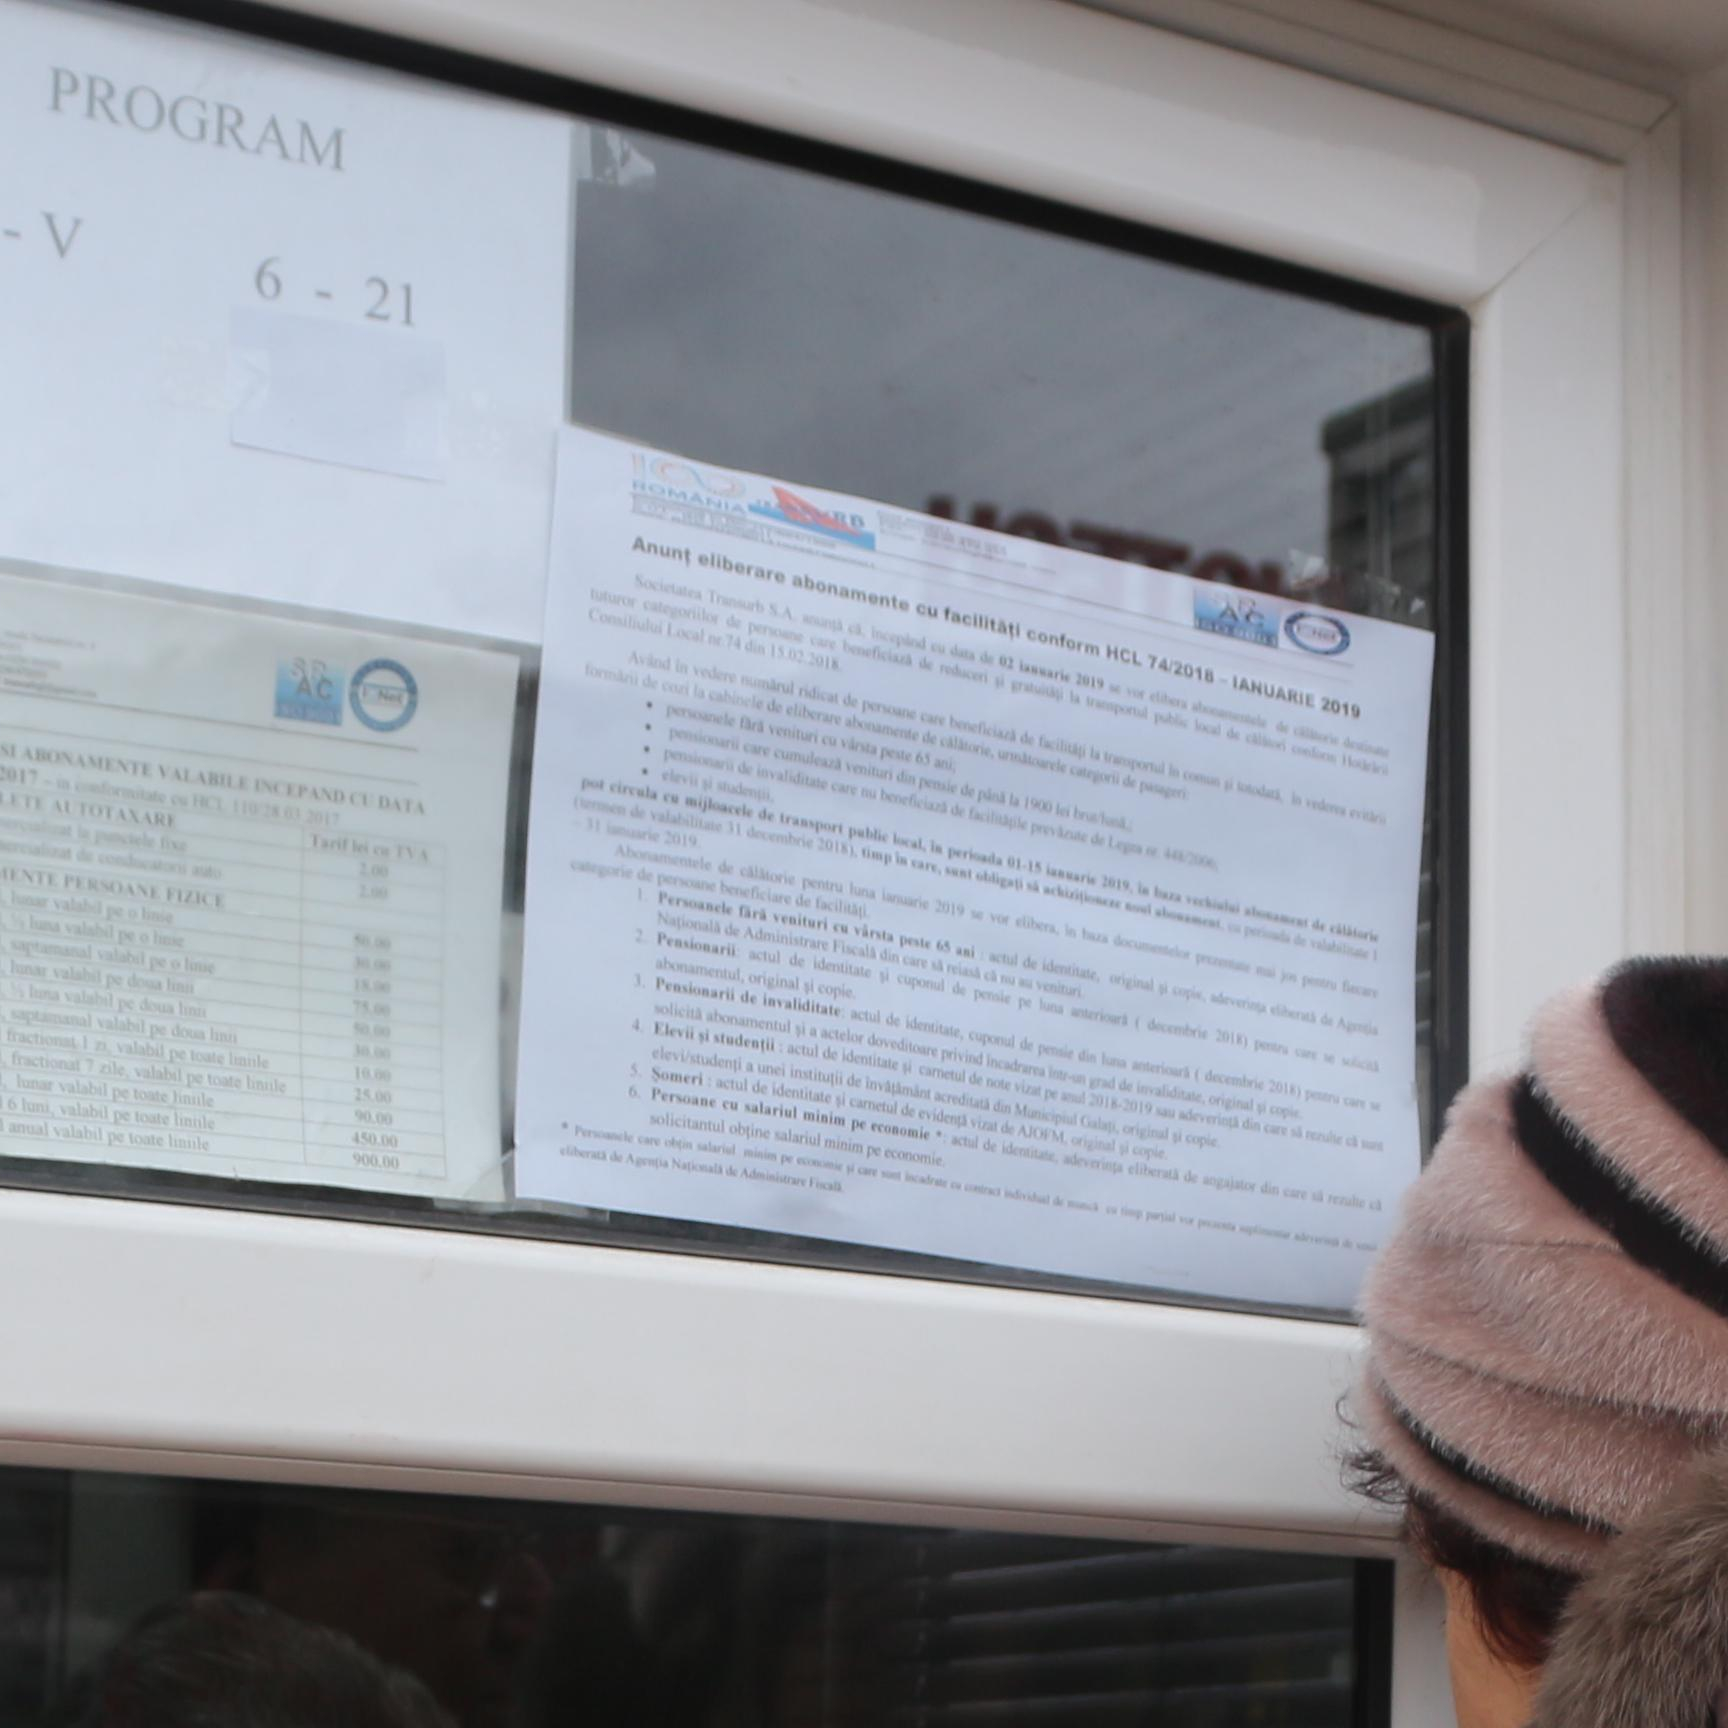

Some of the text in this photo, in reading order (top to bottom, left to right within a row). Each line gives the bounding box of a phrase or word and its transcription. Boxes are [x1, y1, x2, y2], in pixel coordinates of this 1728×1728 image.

[48, 66, 348, 172] PROGRAM
[40, 212, 84, 260] V
[254, 257, 283, 302] 6
[363, 277, 418, 328] 21
[632, 479, 747, 514] ROMÂNIA
[631, 536, 691, 568] Anunț
[697, 551, 785, 585] eliberare
[791, 572, 909, 613] abonamente
[915, 604, 938, 620] cu
[943, 607, 1020, 642] facilități
[1026, 626, 1099, 657] conform
[1105, 644, 1142, 667] HCL
[1232, 675, 1314, 708] IANUARIE
[1321, 696, 1361, 719] 2019
[665, 700, 735, 731] persoanele
[767, 721, 818, 744] venituri
[821, 735, 837, 747] cu
[879, 743, 912, 766] peste
[915, 750, 930, 766] 65
[63, 874, 159, 900] PERSOANE
[166, 887, 227, 908] FIZICE
[658, 891, 734, 916] Persoanele
[772, 911, 828, 932] venituri
[832, 924, 848, 936] cu
[899, 933, 931, 954] peste
[935, 940, 951, 954] 65
[956, 943, 975, 958] ani
[655, 976, 735, 1001] Pensionarii
[739, 989, 759, 1005] de
[649, 1109, 725, 1134] solicitantul
[774, 1128, 821, 1148] salariul
[824, 1135, 863, 1154] minim
[866, 1145, 880, 1161] pe
[651, 1086, 716, 1109] Persoane
[721, 1100, 738, 1112] cu
[744, 1100, 797, 1120] salariul
[802, 1108, 845, 1128] minim
[850, 1119, 865, 1133] pe
[870, 1118, 930, 1140] economie
[351, 1131, 398, 1148] 450.00
[352, 1152, 399, 1170] 900.00
